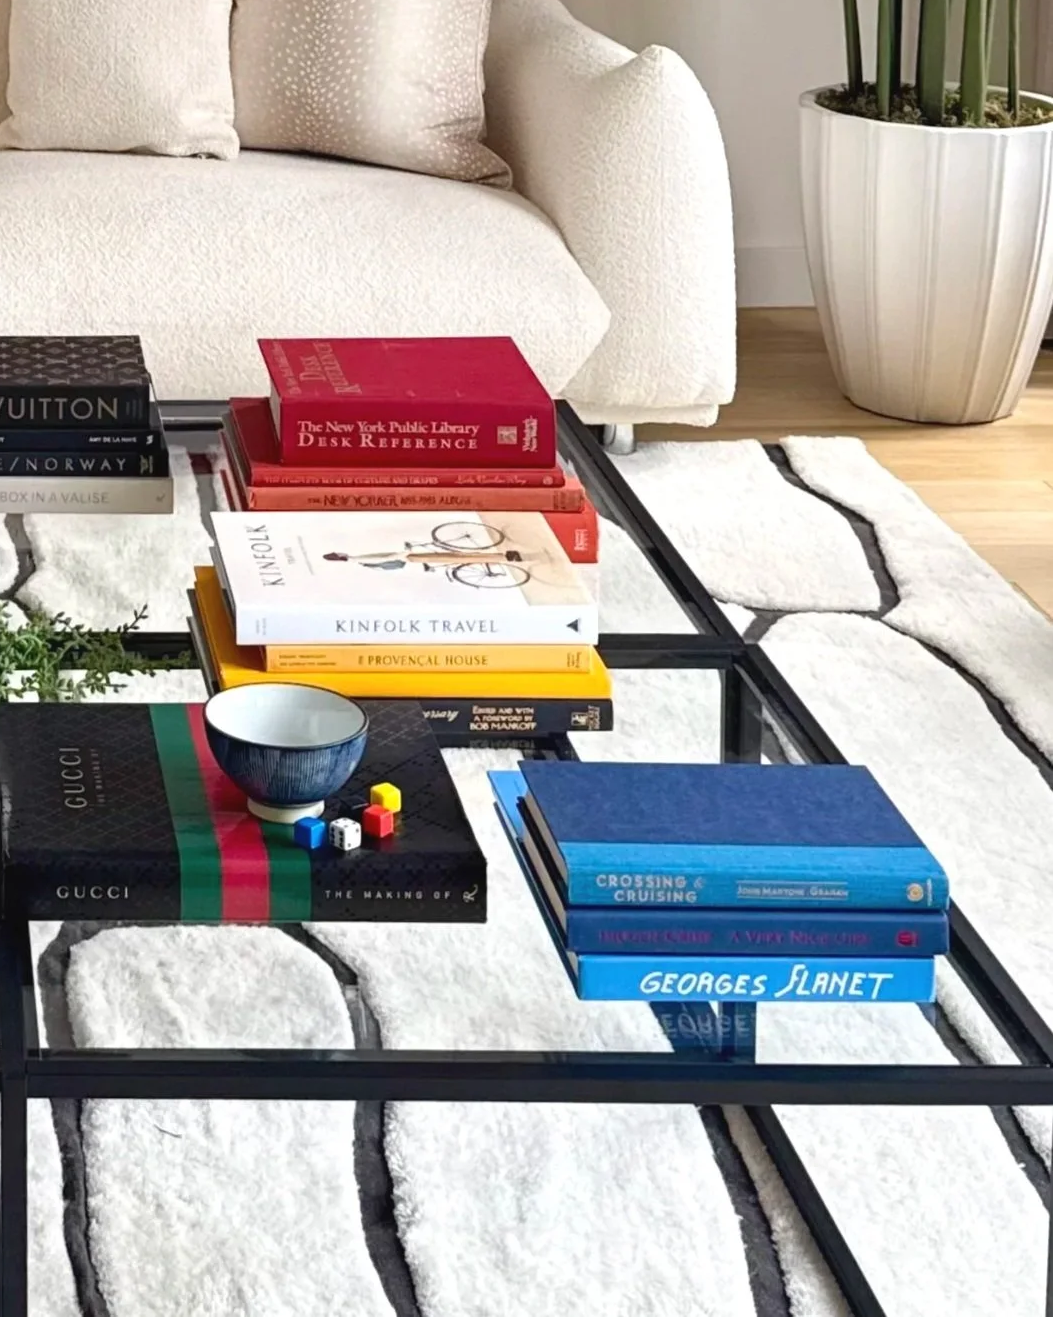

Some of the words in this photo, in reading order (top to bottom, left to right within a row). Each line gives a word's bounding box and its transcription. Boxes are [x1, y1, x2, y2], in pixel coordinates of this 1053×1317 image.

[298, 421, 325, 433] The
[326, 421, 356, 433] New
[357, 421, 387, 433] York
[389, 421, 429, 433] Public
[431, 421, 480, 437] Library
[297, 434, 353, 448] DESK
[360, 434, 478, 449] REFERENCE
[0, 491, 28, 503] BOX
[31, 491, 44, 503] IN
[47, 492, 58, 503] A
[60, 492, 110, 504] VALISE
[244, 523, 286, 587] KINFOLK
[335, 619, 422, 633] KINFOLK
[429, 619, 499, 633] TRAVEL
[368, 654, 441, 668] PROVENÇAL
[445, 654, 489, 666] HOUSE
[469, 722, 490, 731] BOB
[58, 747, 88, 809] GUCCI
[595, 874, 688, 889] CROSSING
[56, 885, 129, 900] GUCCI
[325, 889, 354, 900] THE
[363, 889, 424, 900] MAKING
[433, 889, 451, 900] OF
[613, 890, 698, 904] CRUISING
[639, 971, 768, 996] GEORGES
